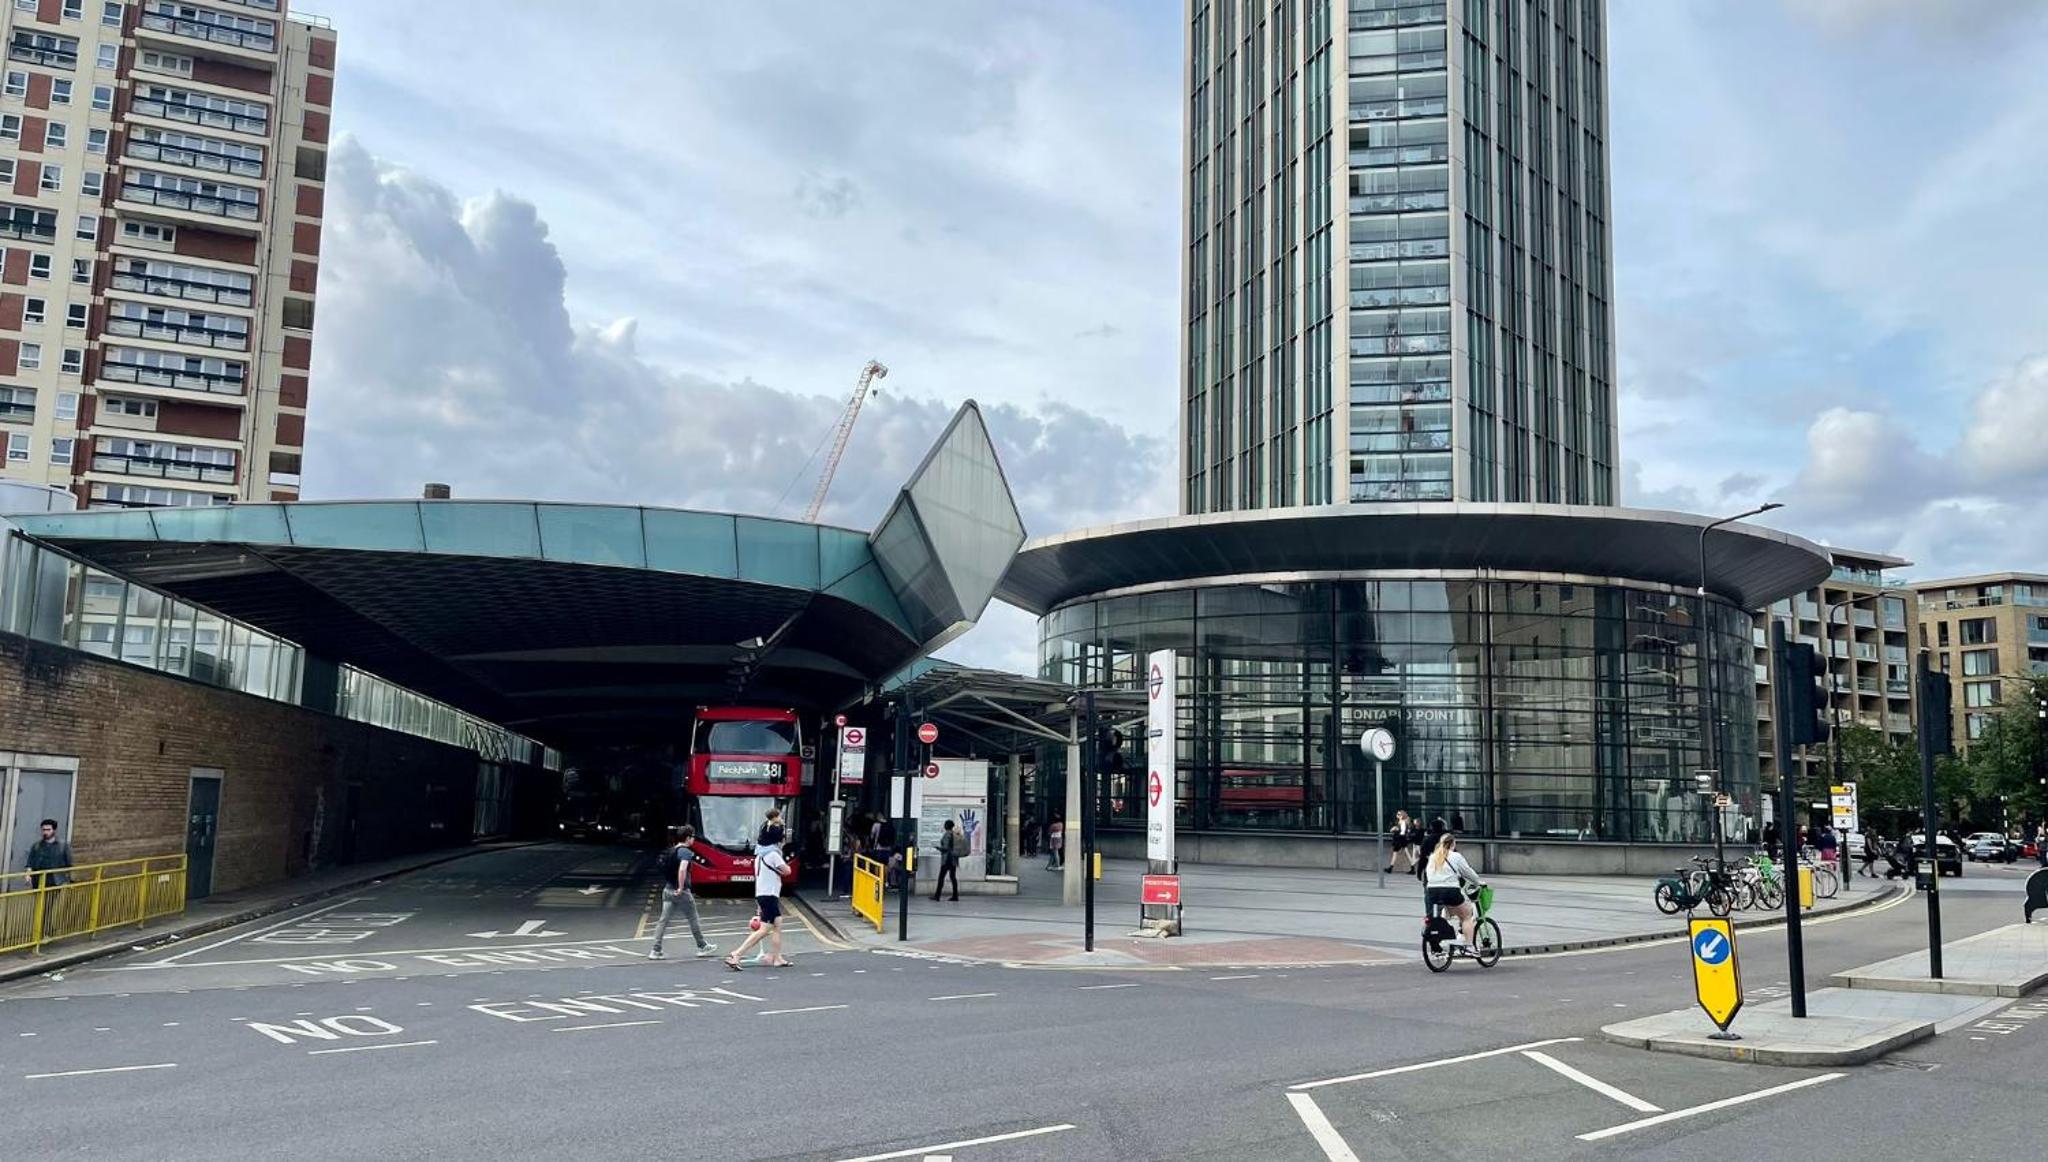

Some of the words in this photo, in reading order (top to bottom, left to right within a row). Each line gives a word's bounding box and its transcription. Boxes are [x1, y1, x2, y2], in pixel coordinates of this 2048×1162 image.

[1416, 709, 1455, 721] POINT
[718, 765, 757, 775] Peckham
[762, 764, 782, 777] 381
[926, 765, 937, 776] C
[277, 959, 399, 976] NO
[414, 945, 649, 967] ENTRY
[247, 1015, 405, 1044] NO
[467, 986, 767, 1022] ENTRY
